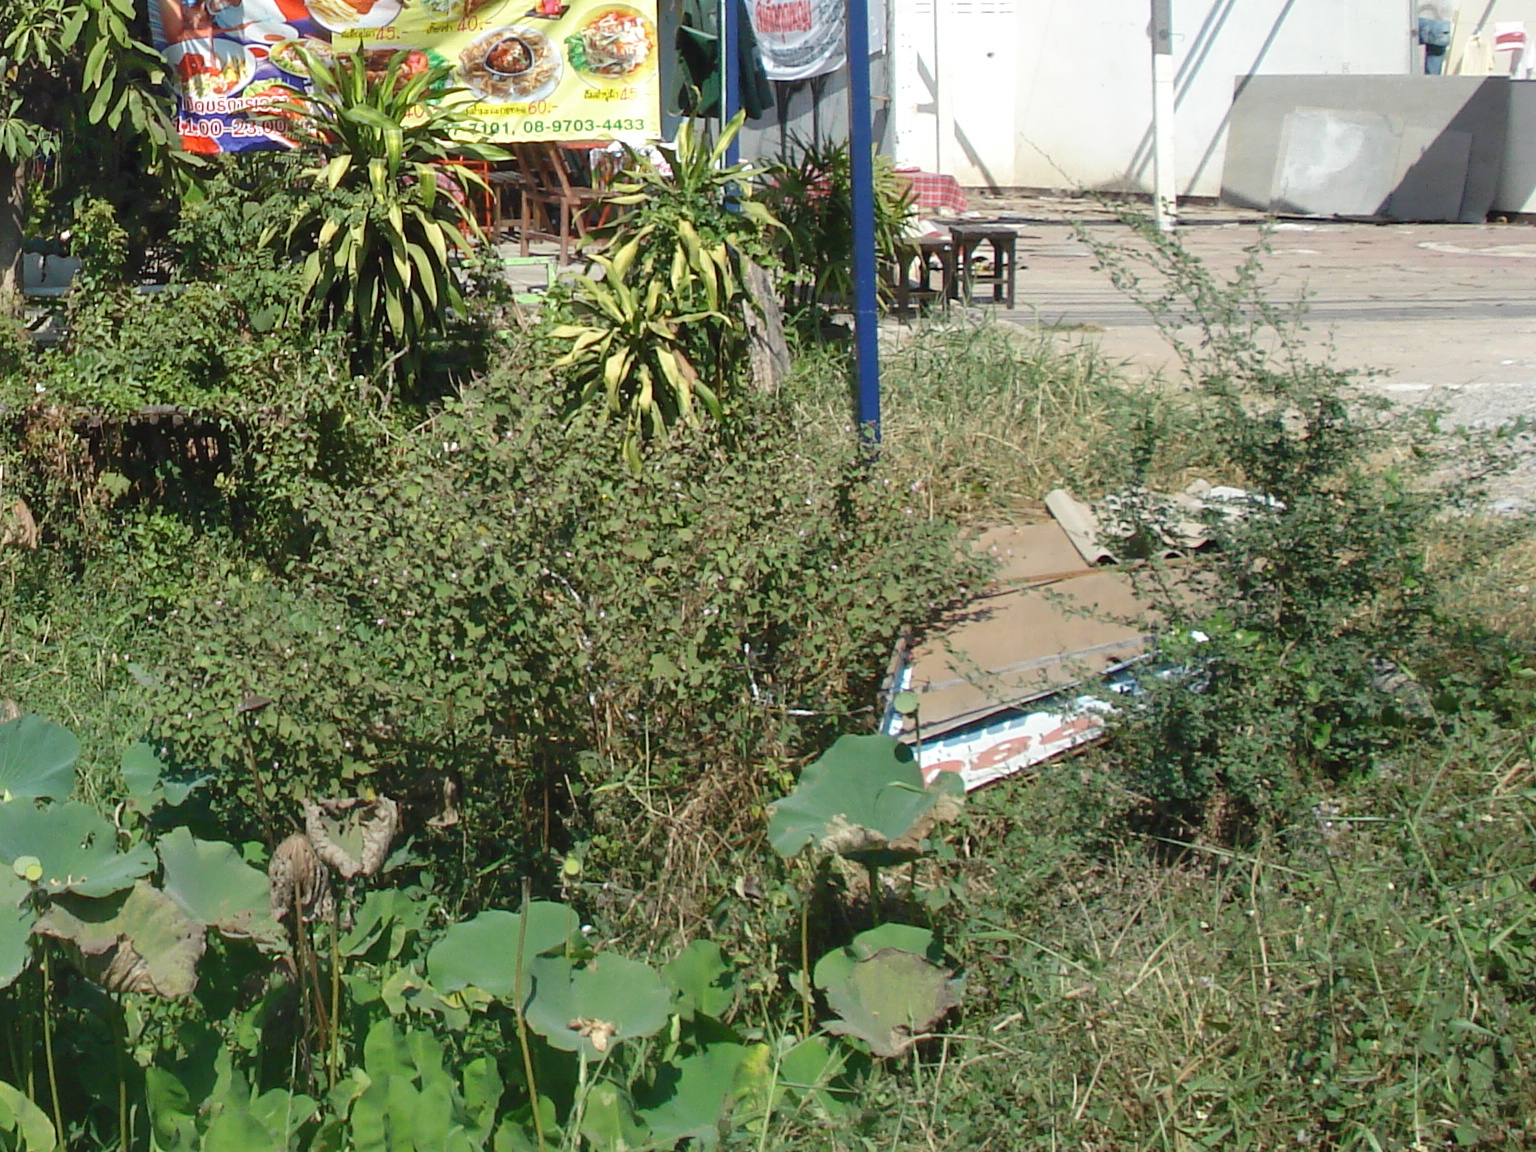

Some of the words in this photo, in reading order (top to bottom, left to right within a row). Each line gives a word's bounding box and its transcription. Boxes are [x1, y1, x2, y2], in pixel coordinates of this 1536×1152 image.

[456, 14, 492, 32] 40.-
[375, 25, 409, 41] 45.-
[523, 118, 645, 134] 08-9703-4433
